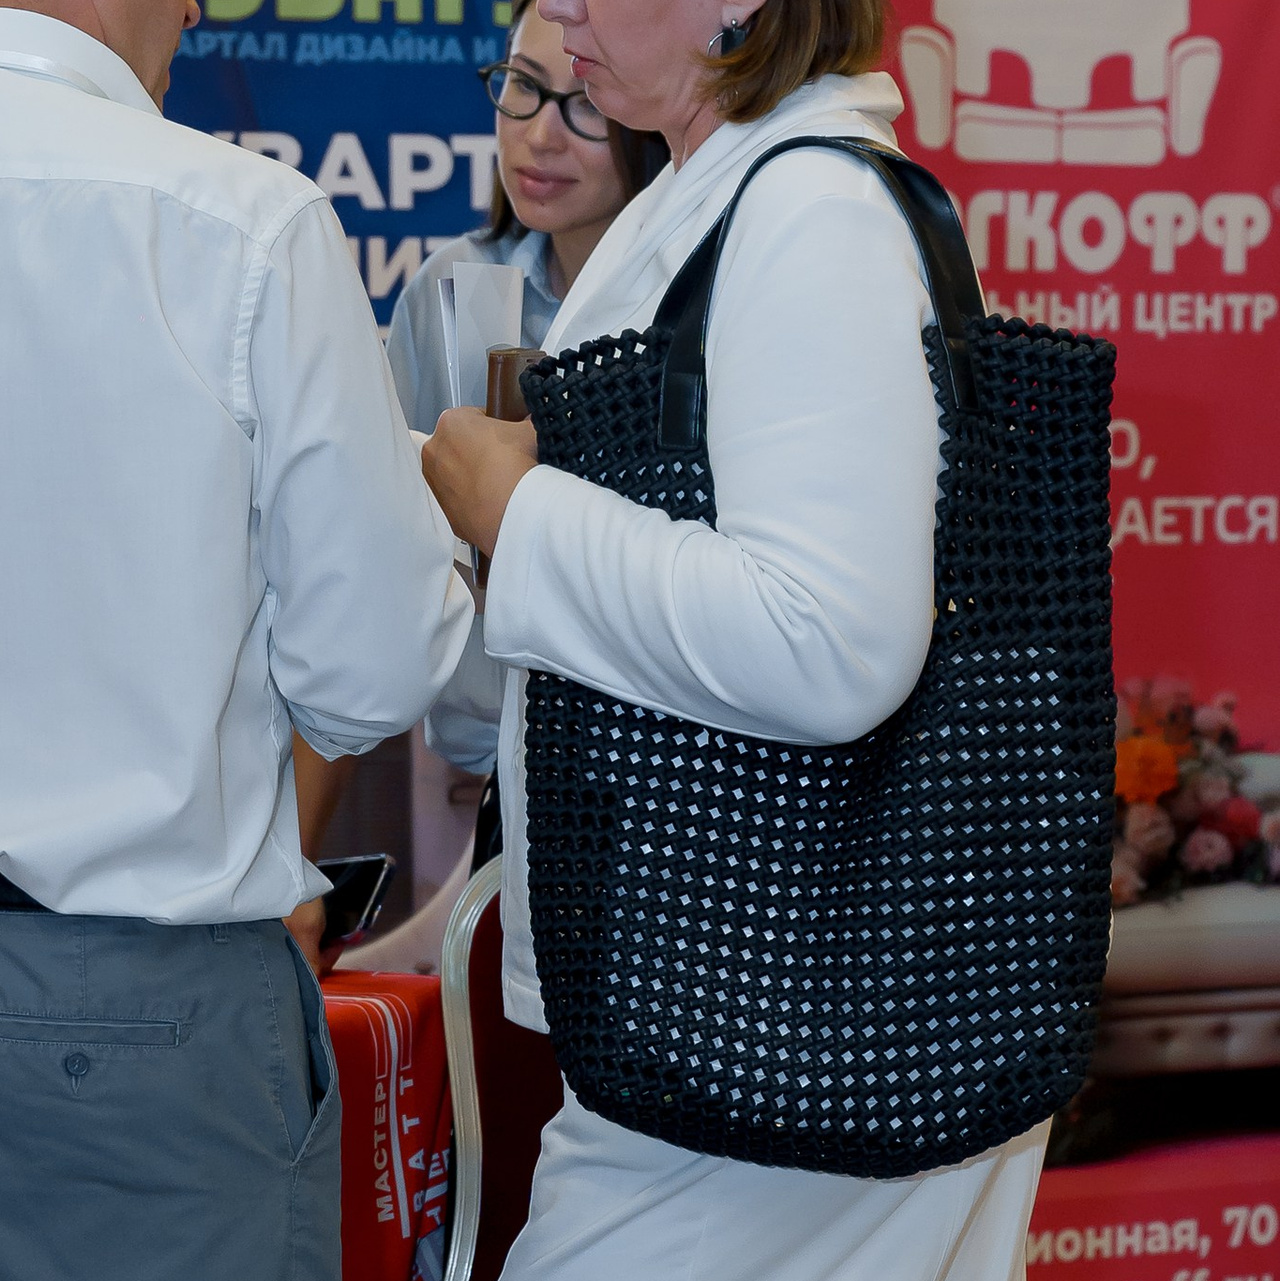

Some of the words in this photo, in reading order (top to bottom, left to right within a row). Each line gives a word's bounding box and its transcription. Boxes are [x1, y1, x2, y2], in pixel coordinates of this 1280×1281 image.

[177, 31, 287, 61] АРТАЛ
[294, 28, 465, 67] ДИЗАЙНА
[473, 38, 498, 65] И
[214, 131, 498, 212] АРТ
[950, 190, 1272, 274] ГКОФФ
[985, 285, 1119, 333] ЬНЫЙ
[1133, 292, 1278, 339] ЦЕНТР
[1109, 419, 1158, 482] О,
[1109, 497, 1278, 546] АЕТСЯ
[374, 1081, 395, 1222] МАСТЕР
[1026, 1217, 1212, 1267] ионная,
[1222, 1204, 1278, 1249] 70
